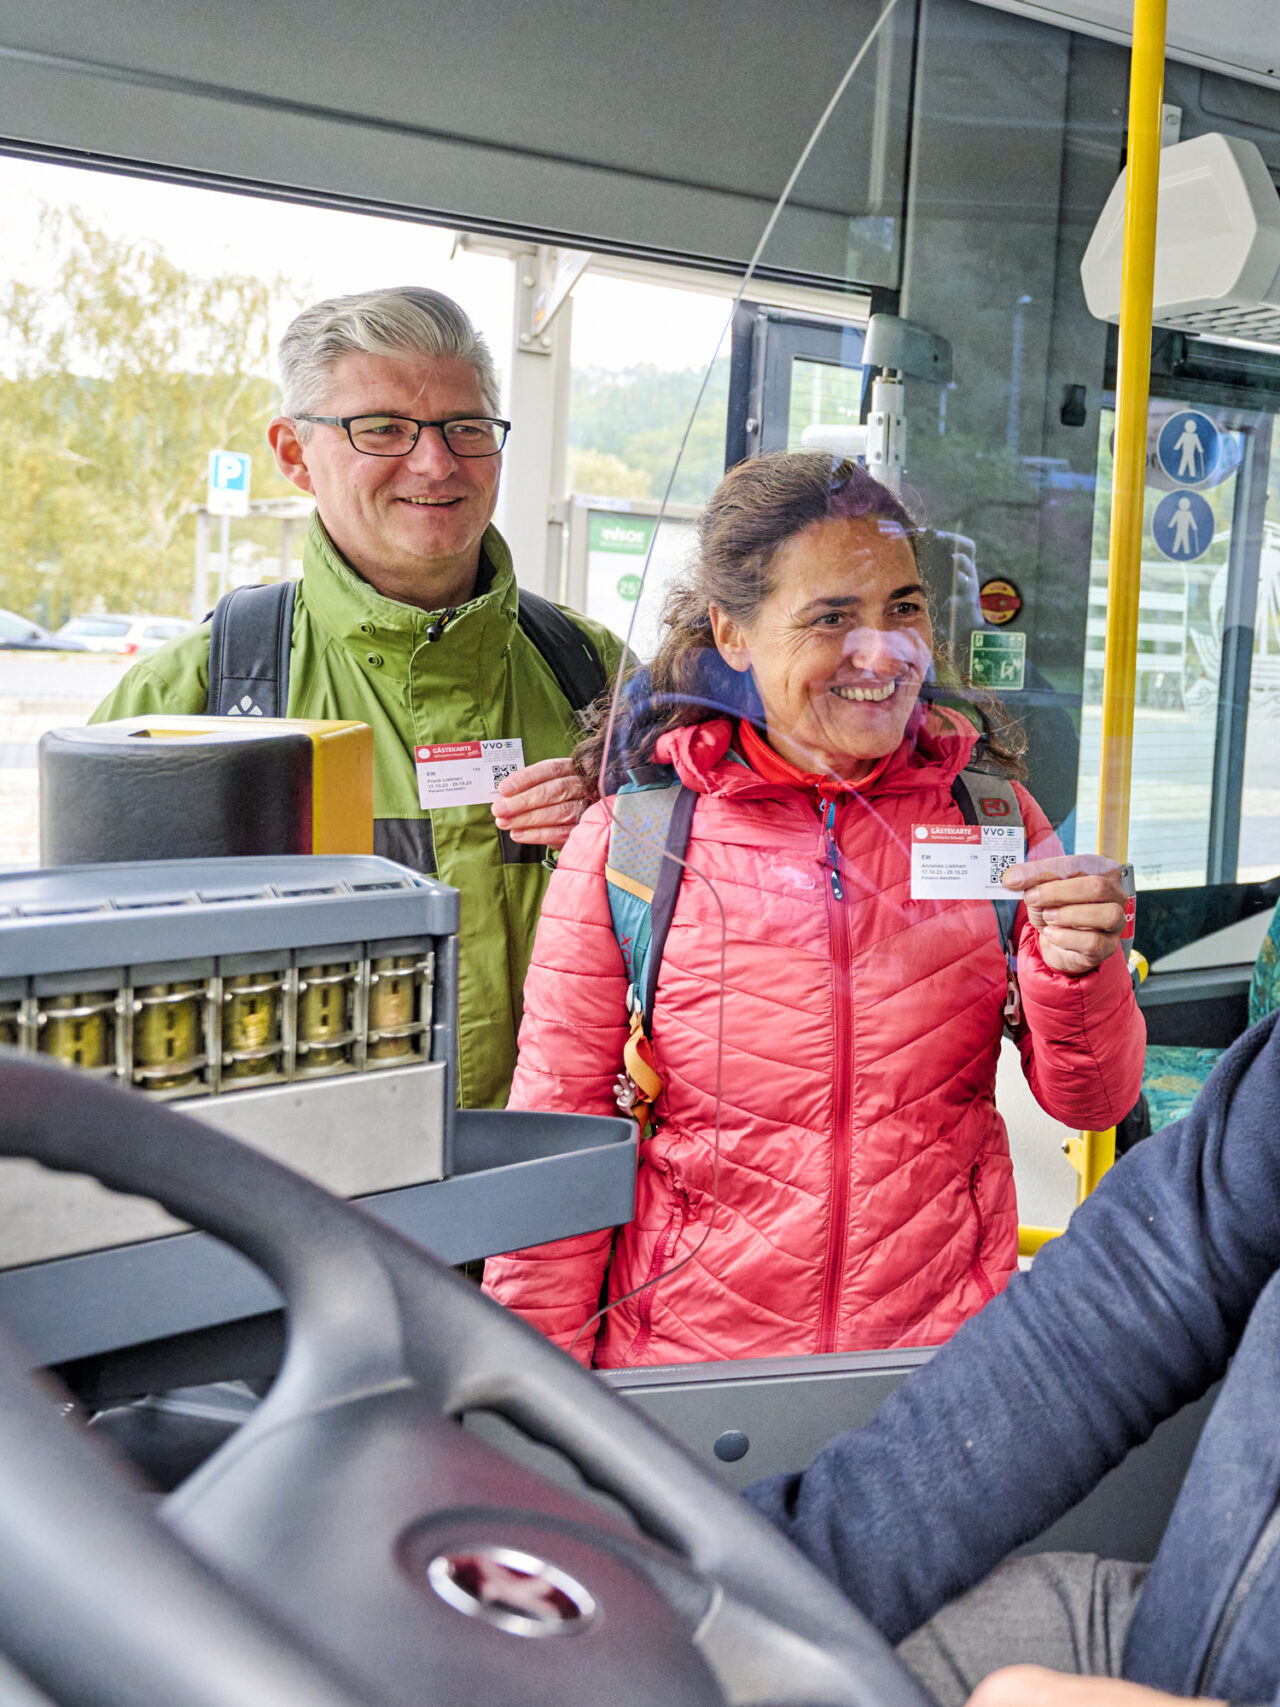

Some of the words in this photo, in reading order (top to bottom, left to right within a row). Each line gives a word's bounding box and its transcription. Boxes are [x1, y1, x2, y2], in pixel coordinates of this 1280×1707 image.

[217, 456, 242, 488] P
[432, 745, 472, 753] GÄSTEKARTE
[482, 742, 503, 750] VVO
[930, 827, 972, 835] GÄSTEKARTE
[983, 828, 1005, 836] VVO
